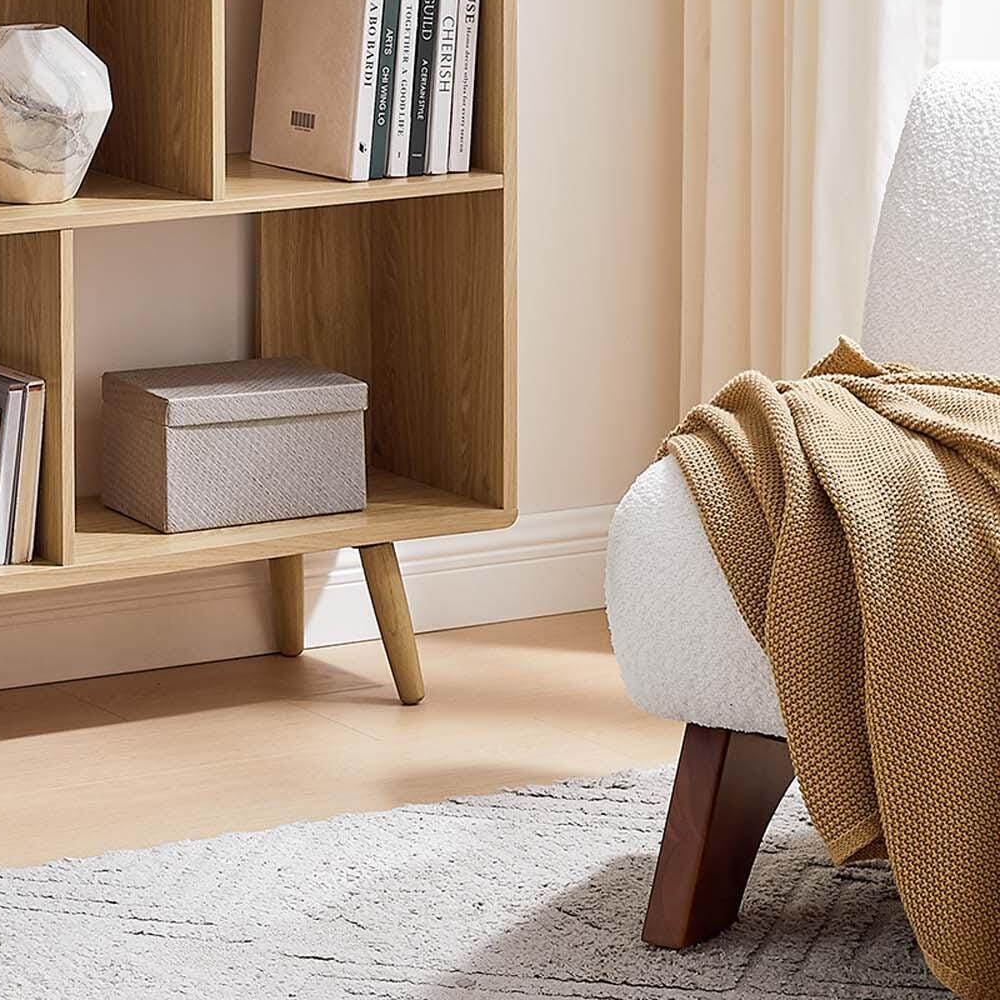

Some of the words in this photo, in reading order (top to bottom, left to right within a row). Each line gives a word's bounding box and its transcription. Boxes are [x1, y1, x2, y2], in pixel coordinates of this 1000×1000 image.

[384, 28, 394, 56] ARTS
[439, 16, 455, 92] CHERISH
[364, 40, 376, 87] BARDI
[381, 66, 390, 83] CHI
[378, 84, 388, 110] WING
[377, 112, 387, 126] LO
